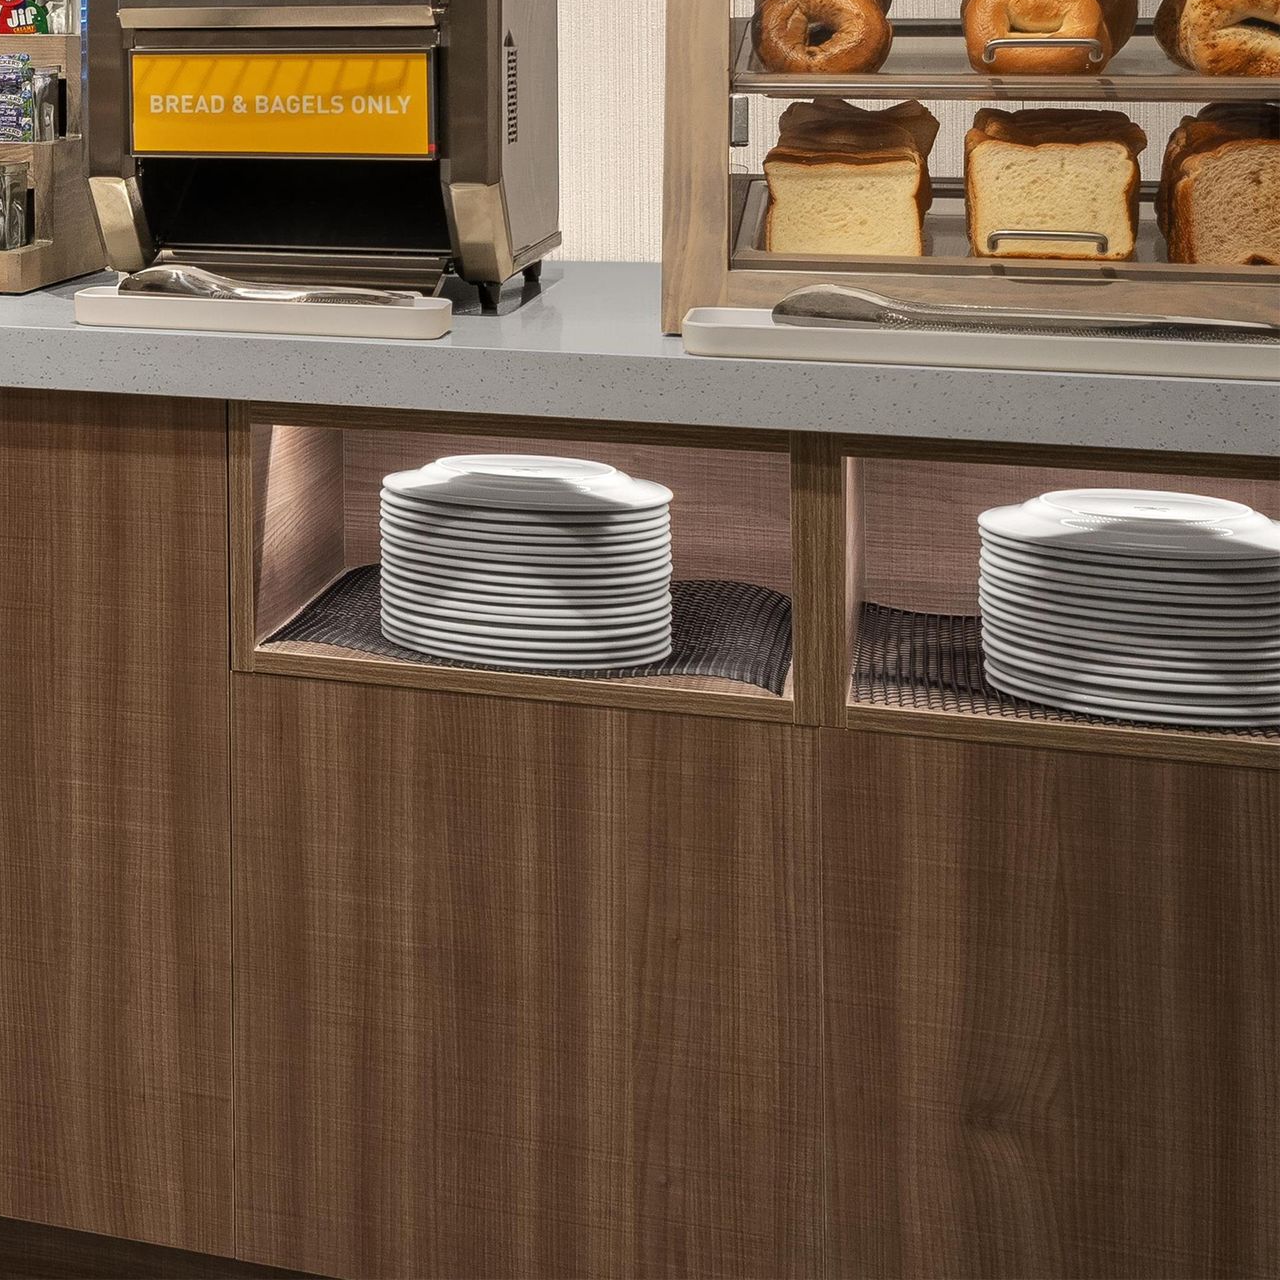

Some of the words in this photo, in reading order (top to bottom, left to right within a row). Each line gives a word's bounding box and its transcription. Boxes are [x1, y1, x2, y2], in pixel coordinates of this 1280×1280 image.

[7, 7, 37, 28] Jif
[149, 95, 225, 114] BREAD
[232, 95, 247, 114] &
[255, 95, 344, 114] BAGELS
[351, 95, 411, 114] ONLY
